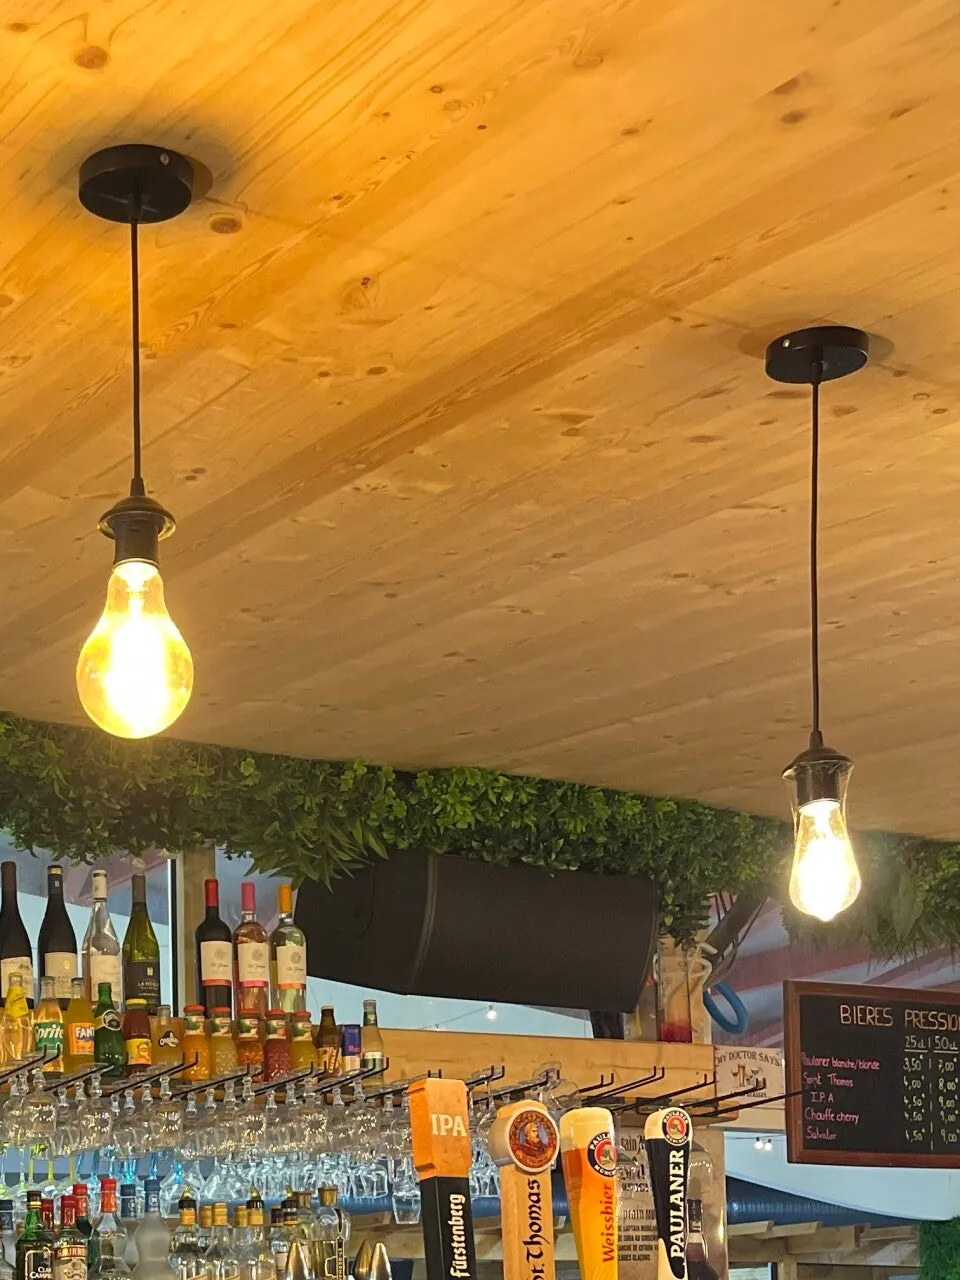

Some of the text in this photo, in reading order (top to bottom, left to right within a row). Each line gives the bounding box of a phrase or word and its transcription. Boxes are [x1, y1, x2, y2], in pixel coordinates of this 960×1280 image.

[840, 1004, 893, 1027] BIERES
[728, 1050, 757, 1061] DOCTOR
[827, 1072, 854, 1087] Thomas
[430, 1113, 468, 1138] IPA
[804, 1106, 835, 1122] Chouffe
[836, 1110, 860, 1126] cherry
[805, 1125, 837, 1141] Salvator
[669, 1149, 685, 1259] PAULANER
[599, 1183, 615, 1264] Weissbier
[447, 1193, 471, 1279] Fürstenberg
